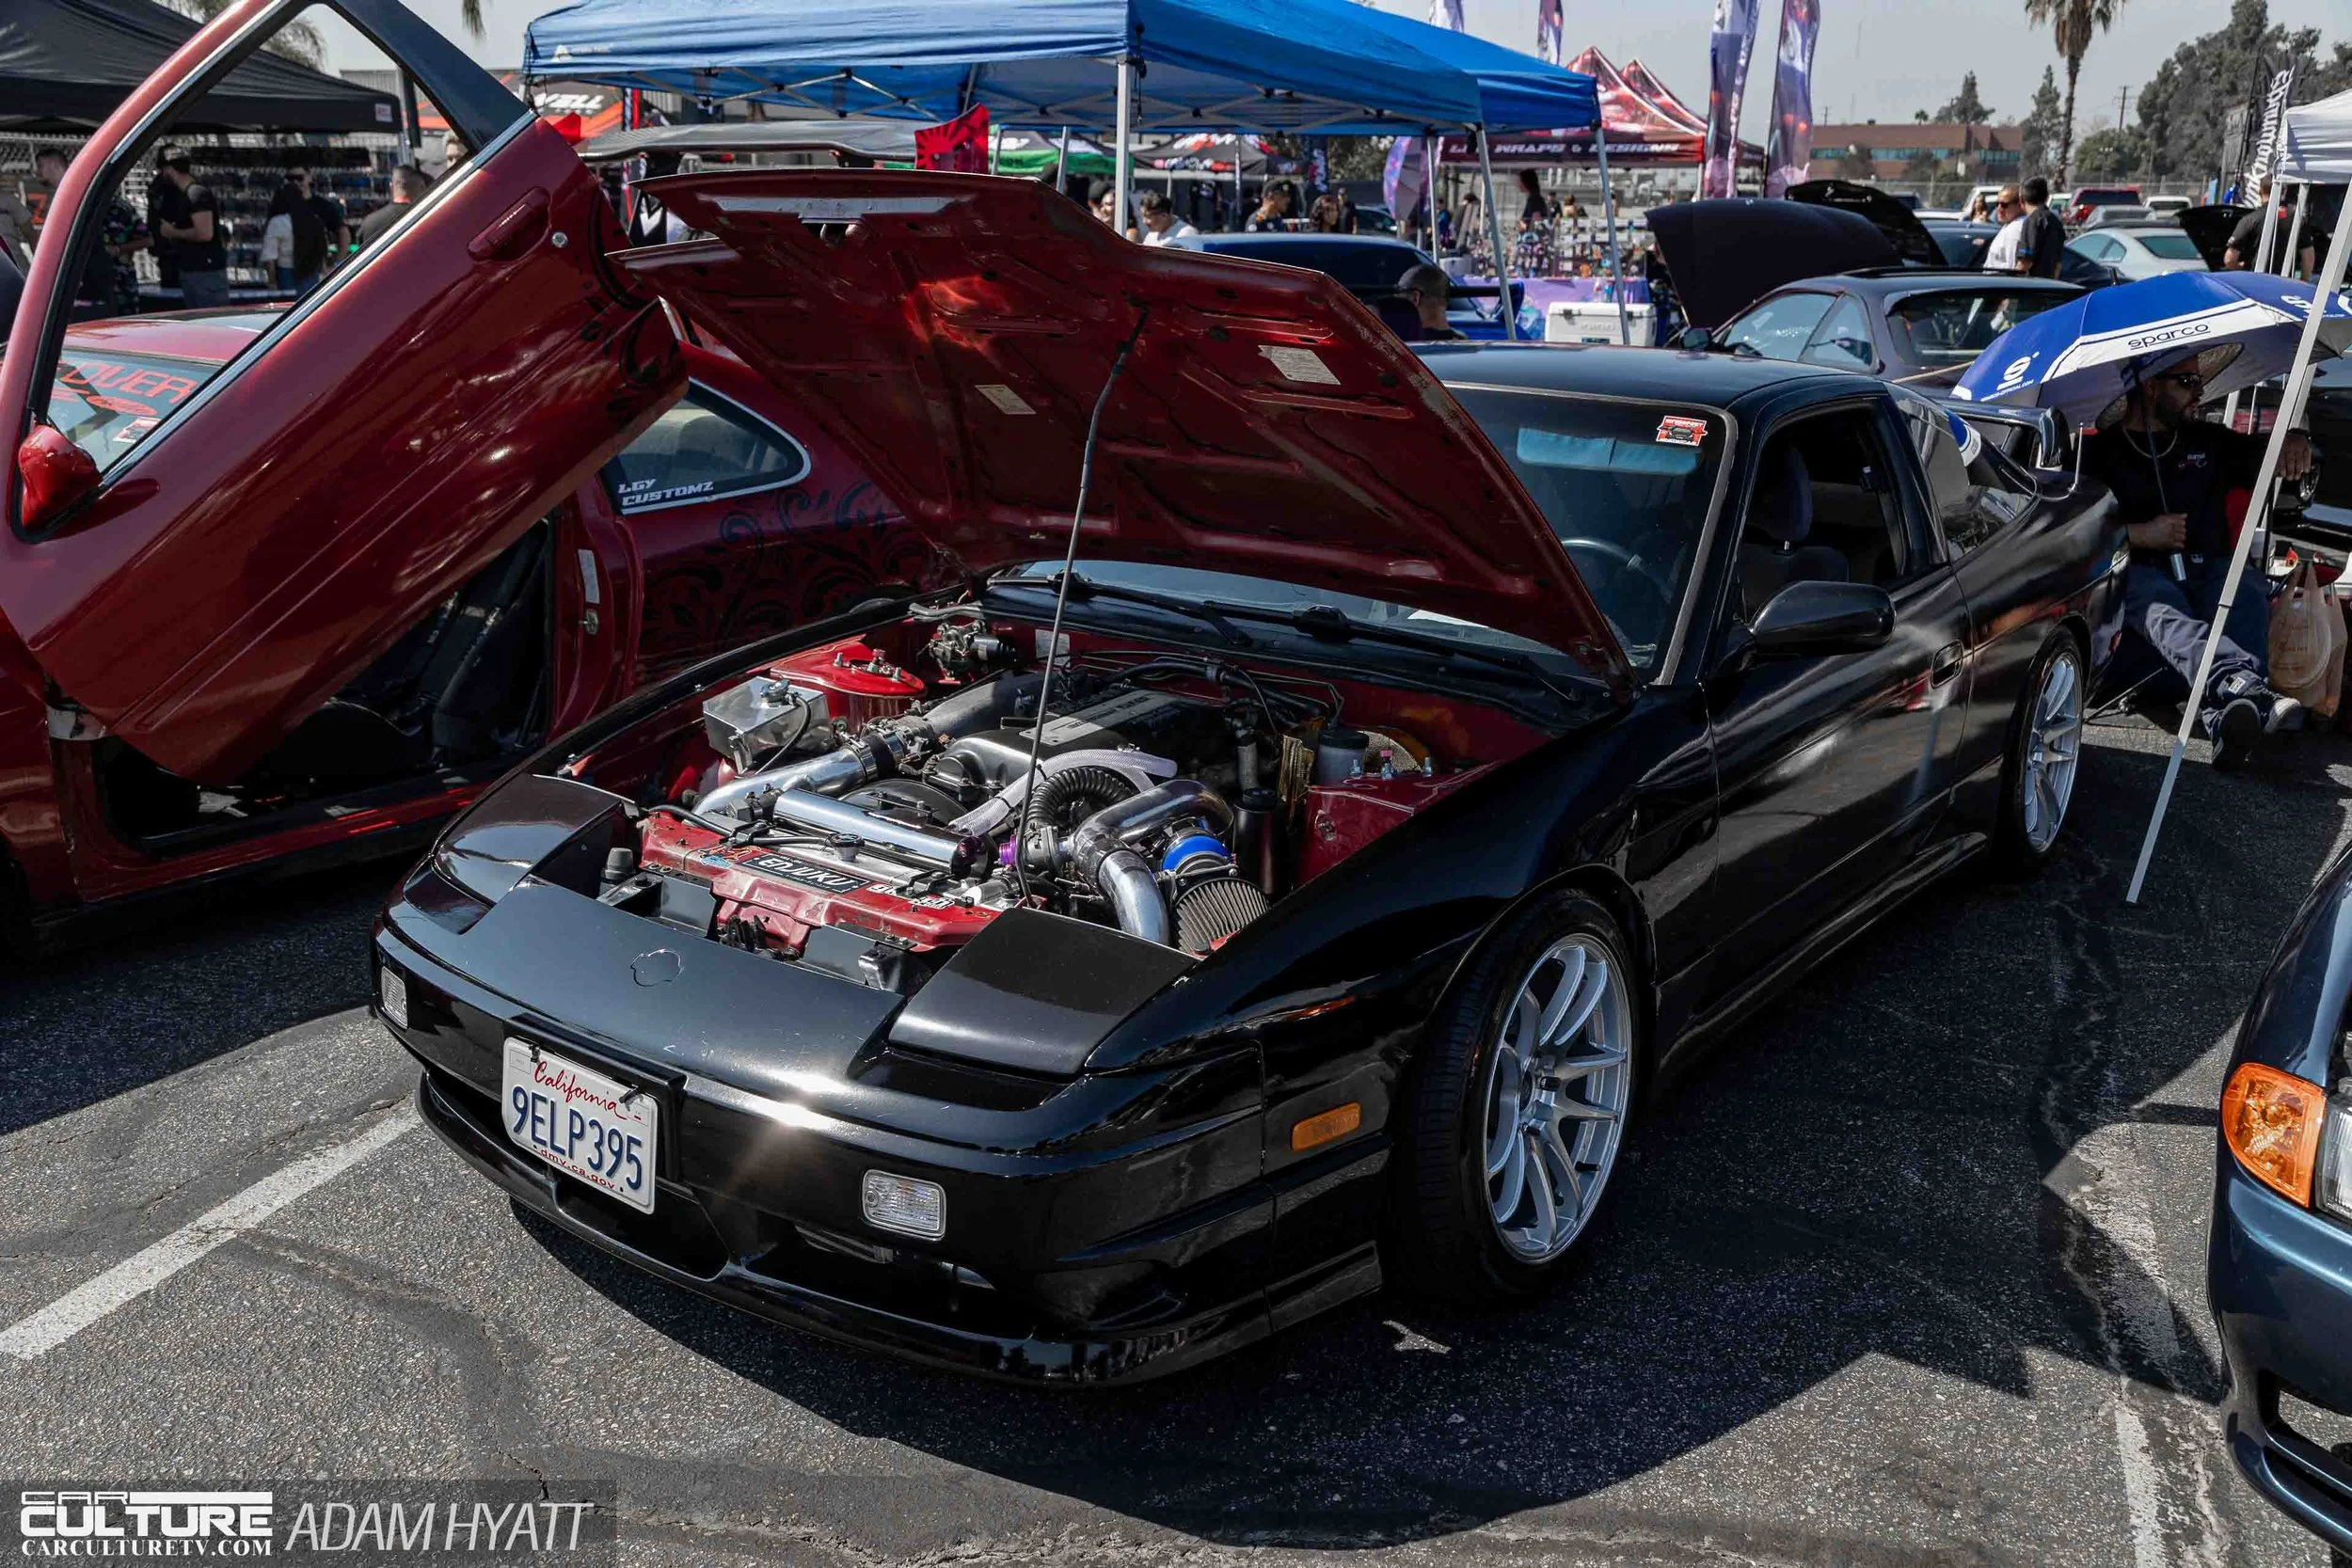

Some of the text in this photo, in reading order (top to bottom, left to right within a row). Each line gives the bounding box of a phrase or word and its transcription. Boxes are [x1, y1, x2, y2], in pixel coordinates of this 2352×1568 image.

[2127, 323, 2210, 349] sparco
[618, 478, 657, 494] LGY
[621, 481, 714, 506] CUSTOMZ
[758, 857, 854, 886] ENJUKU
[533, 1060, 628, 1120] California
[512, 1085, 643, 1190] 9ELP395
[540, 1148, 616, 1190] dmv.ca.gov
